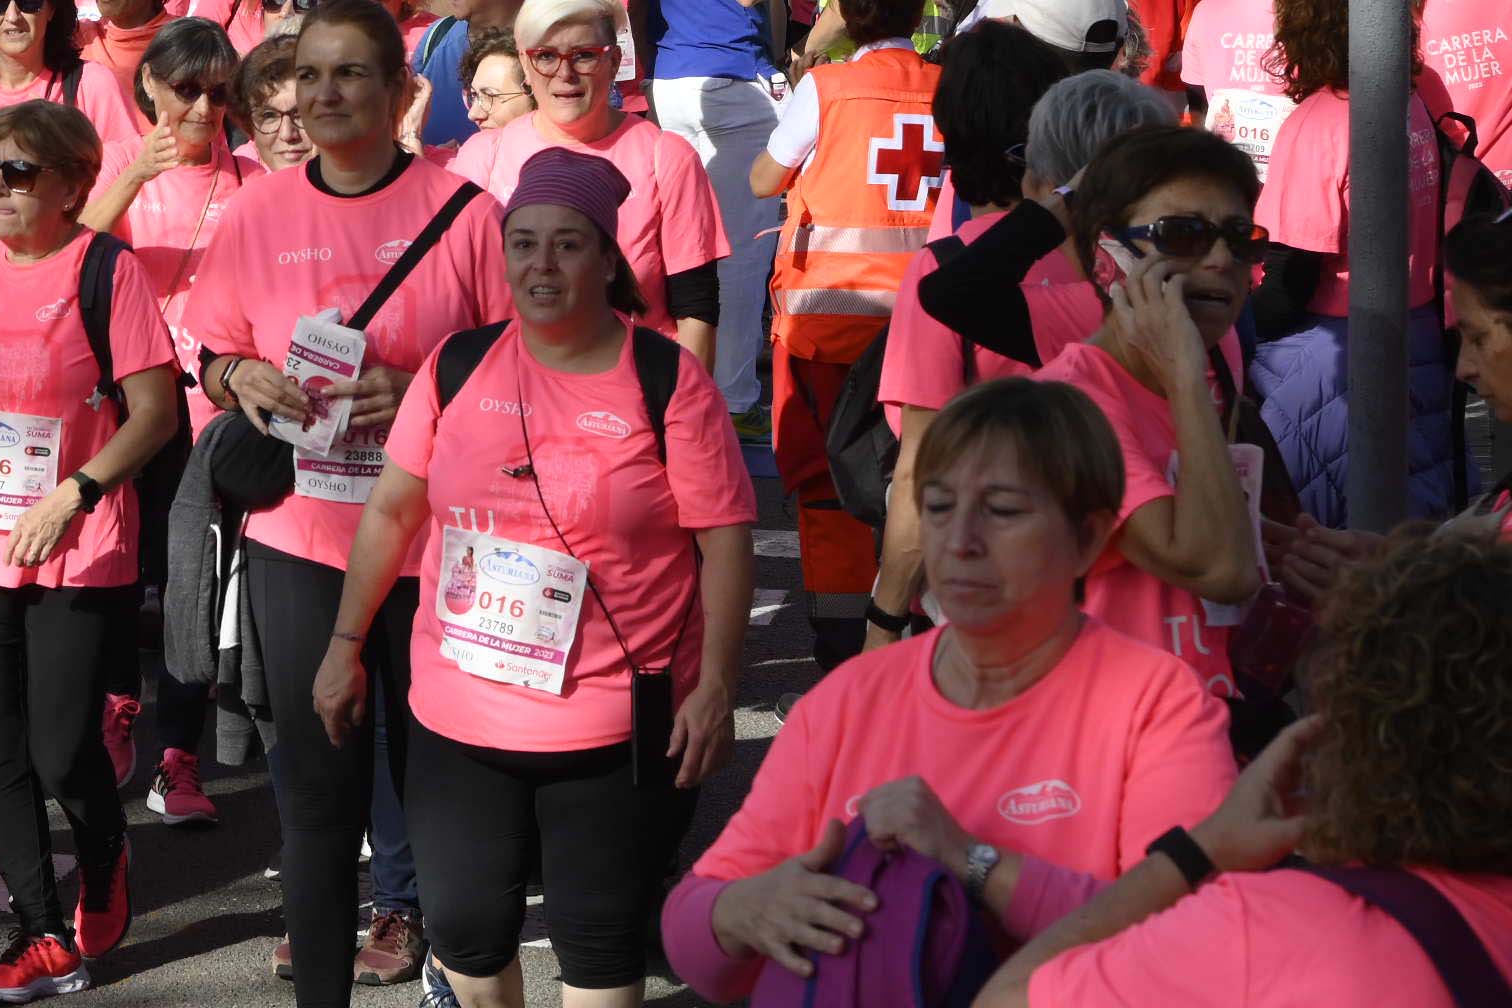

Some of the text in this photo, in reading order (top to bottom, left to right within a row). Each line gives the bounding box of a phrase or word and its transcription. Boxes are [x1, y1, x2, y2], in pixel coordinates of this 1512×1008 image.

[1426, 26, 1508, 56] CARRERA
[1235, 50, 1257, 65] DE
[1443, 47, 1496, 69] DE LA
[1445, 61, 1503, 85] MUJER
[1239, 127, 1270, 141] 016
[279, 247, 332, 265] OYSHO
[307, 333, 350, 356] OYSHO
[302, 350, 340, 370] CARRERA
[25, 430, 52, 439] SUMA
[344, 450, 383, 462] 23888
[311, 462, 373, 475] CARRERA DE LA
[308, 478, 347, 493] OYSHO
[449, 506, 495, 535] TU
[488, 559, 536, 582] ASTURIANA
[479, 591, 525, 618] 016
[479, 616, 514, 635] 23789
[444, 624, 555, 660] CARRERA DE LA MUJER 2023
